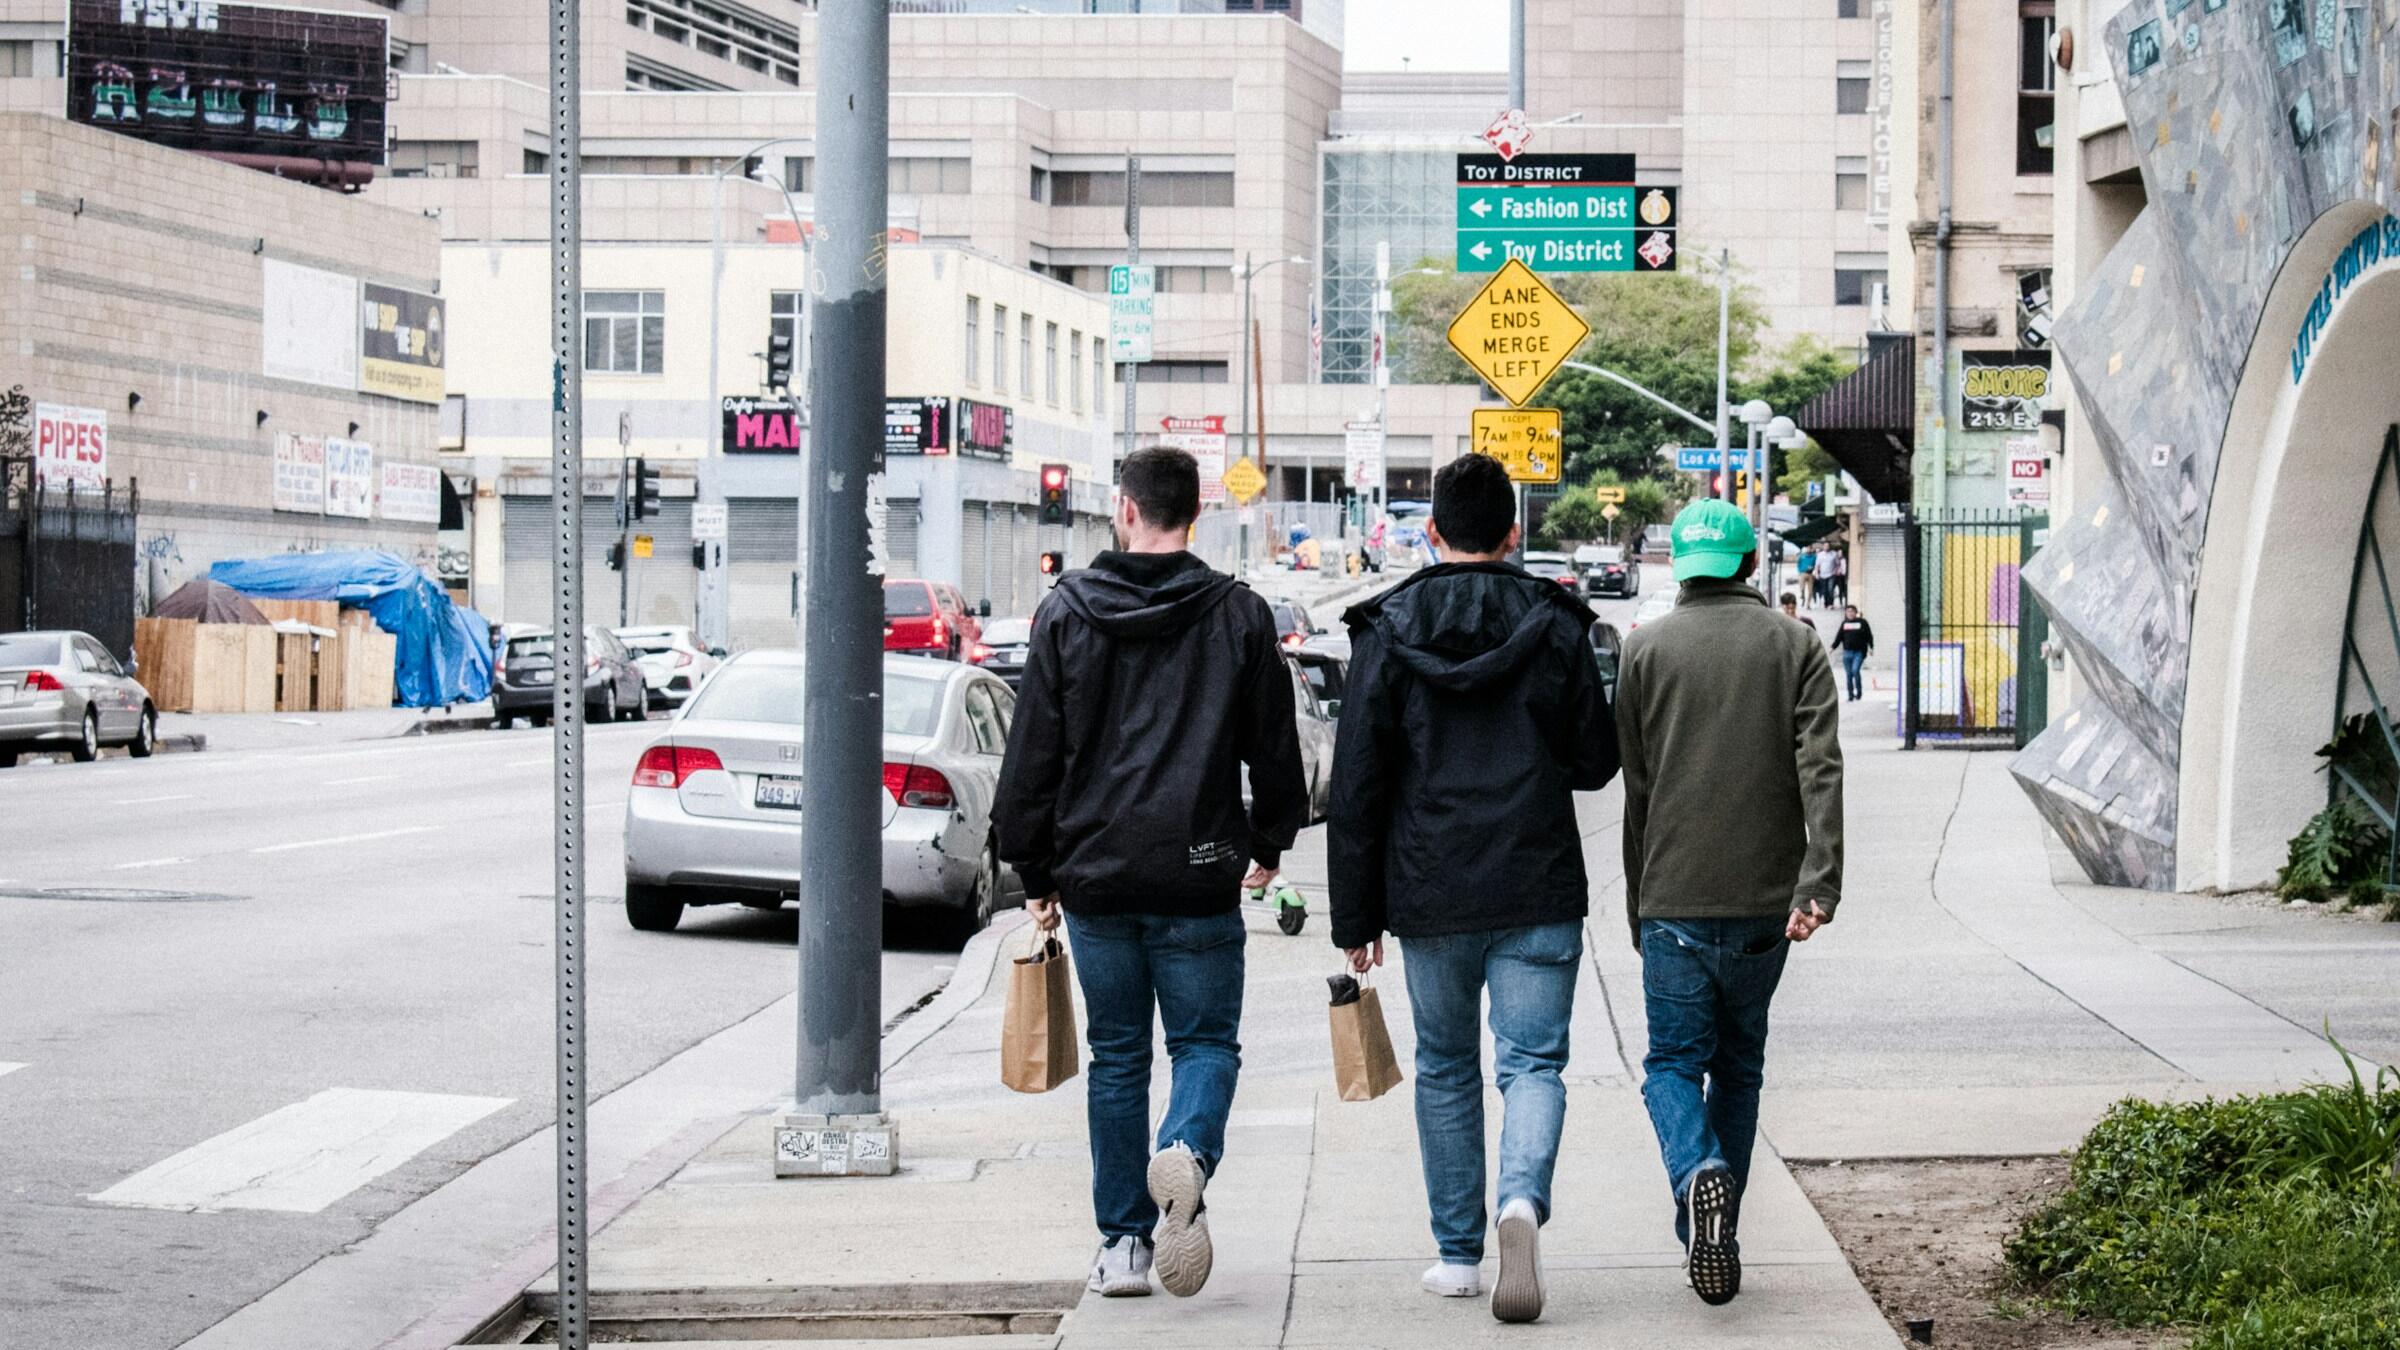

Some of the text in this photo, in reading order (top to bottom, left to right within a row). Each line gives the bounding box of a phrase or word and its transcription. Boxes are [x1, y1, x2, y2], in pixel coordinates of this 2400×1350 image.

[1879, 18, 1892, 105] GEORGE
[1874, 119, 1890, 214] HOTEL
[1501, 197, 1627, 219] Fashion Dist
[1502, 239, 1623, 265] Toy District
[1113, 270, 1150, 292] 15 MIN
[1489, 286, 1541, 305] LANE
[2291, 273, 2332, 385] LITTLE
[2333, 219, 2381, 300] TOKYO
[1113, 298, 1152, 315] PARKING
[1491, 311, 1541, 329] ENDS
[1483, 335, 1550, 354] MERGE
[1493, 360, 1541, 378] LEFT
[1964, 367, 2048, 399] SMOKE
[1168, 419, 1217, 431] ENTRANCE
[1501, 415, 1532, 423] EXCEPT
[1970, 411, 2007, 427] 213
[39, 419, 103, 464] PIPES
[1514, 449, 1523, 458] TO
[1681, 452, 1704, 465] Los
[2014, 461, 2038, 476] NO
